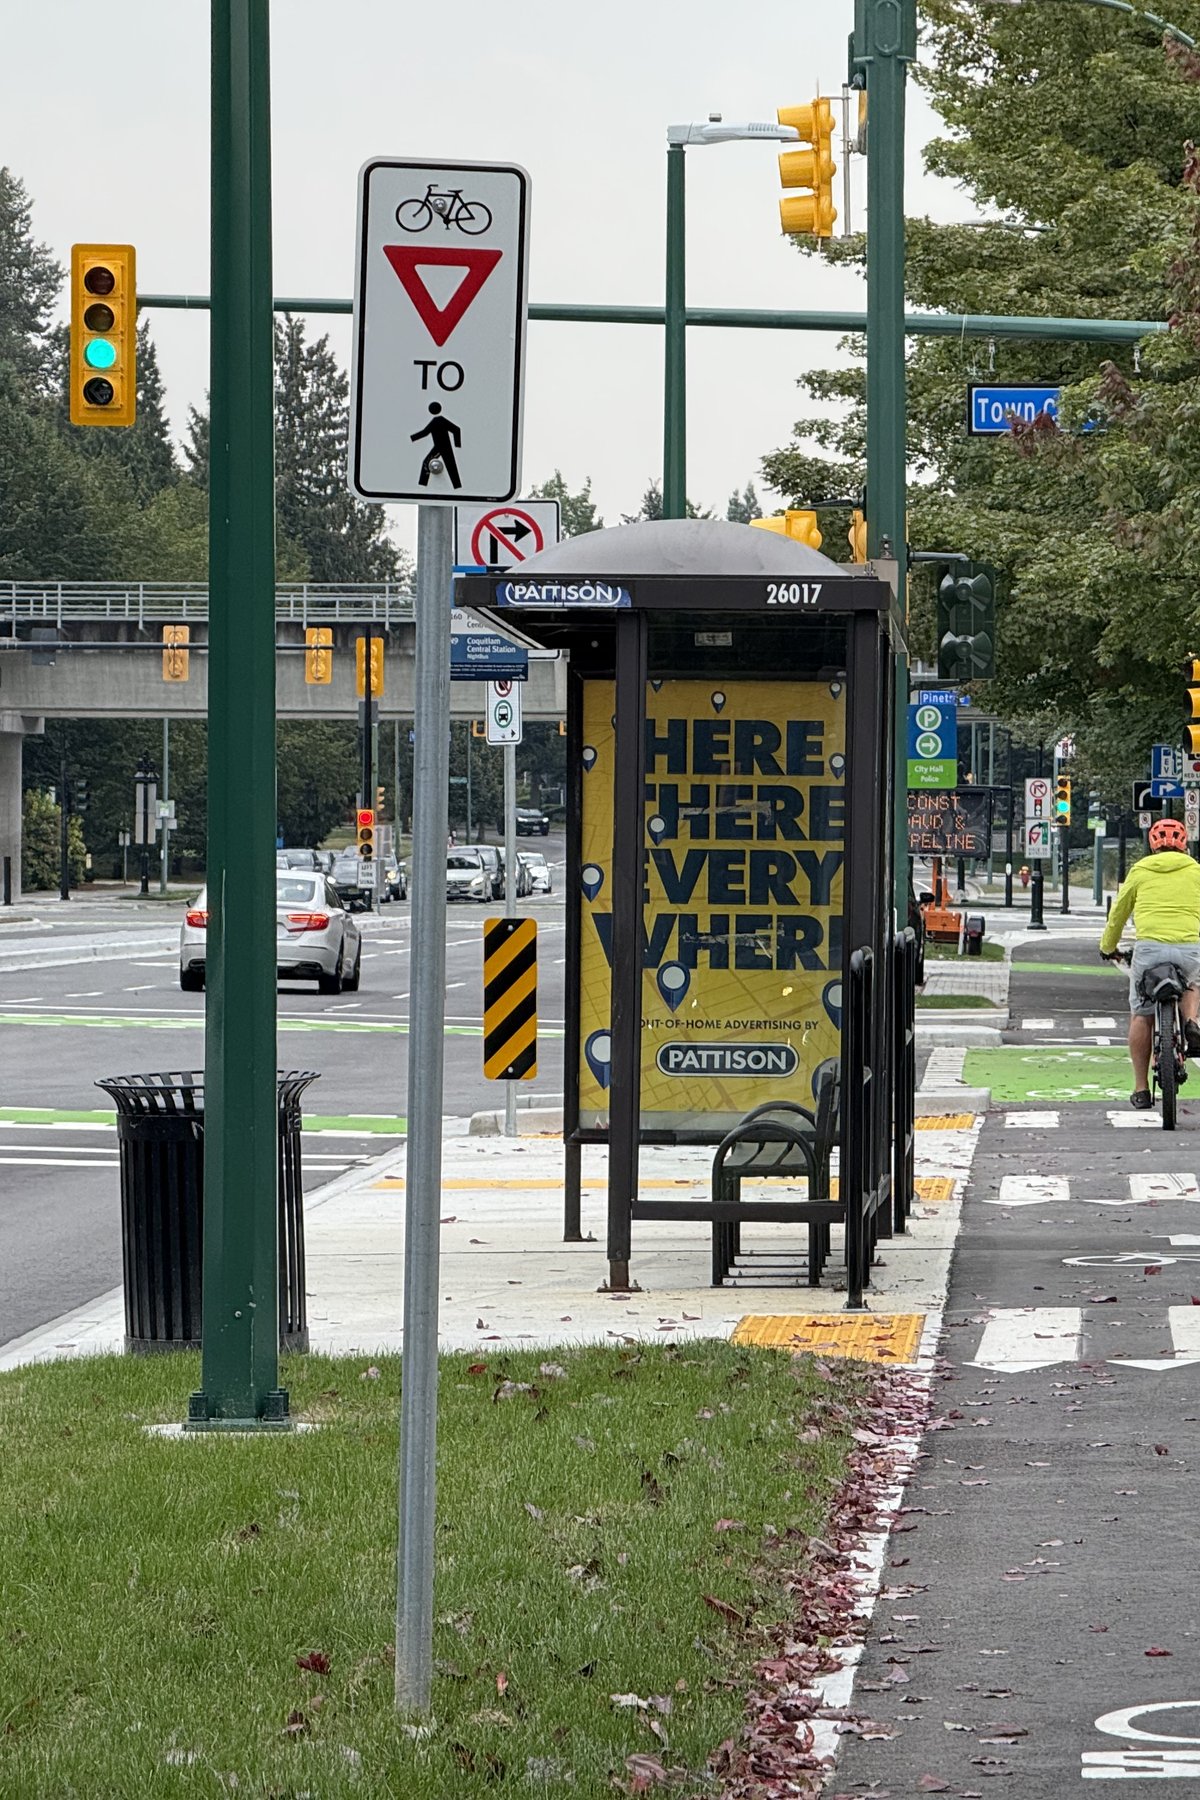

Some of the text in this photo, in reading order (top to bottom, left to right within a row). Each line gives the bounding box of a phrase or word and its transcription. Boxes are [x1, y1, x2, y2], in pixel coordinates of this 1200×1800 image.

[413, 360, 465, 392] TO
[977, 397, 1035, 424] Town
[513, 585, 615, 601] PATTISON
[766, 583, 822, 604] 26017
[466, 637, 501, 646] Coquitlam
[492, 645, 516, 654] Station
[922, 692, 966, 704] Pinete
[646, 719, 825, 776] HERE
[914, 765, 944, 774] City Hall
[920, 775, 939, 783] Police
[907, 794, 961, 811] CONST
[646, 783, 845, 841] HERE
[955, 814, 966, 830] &
[643, 848, 844, 906] VERY
[724, 1019, 802, 1030] ADVERTISING
[804, 1020, 819, 1031] BY
[668, 1050, 787, 1070] PATTISON
